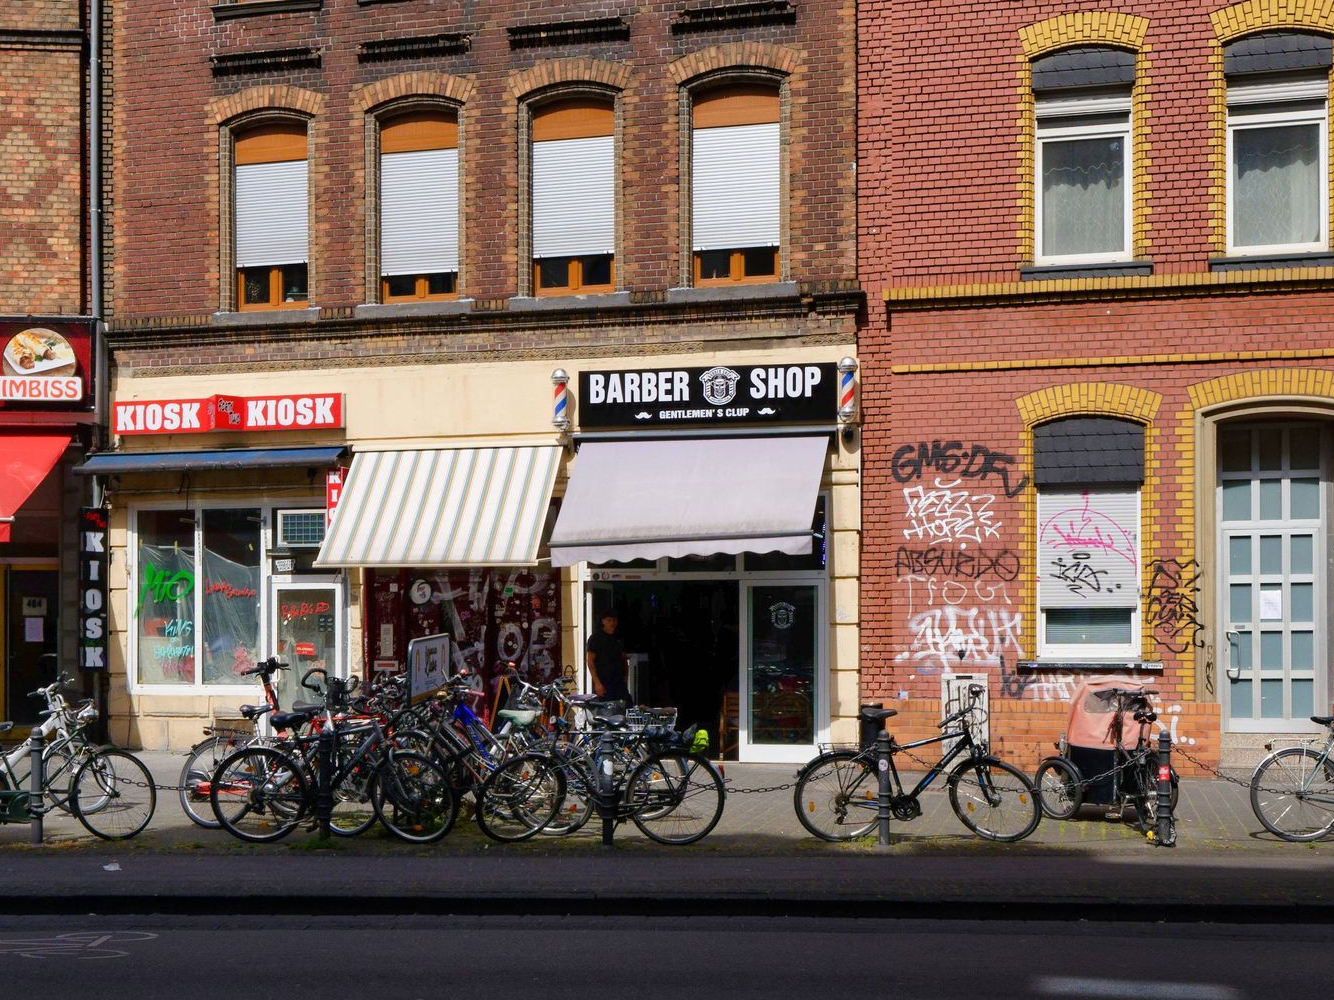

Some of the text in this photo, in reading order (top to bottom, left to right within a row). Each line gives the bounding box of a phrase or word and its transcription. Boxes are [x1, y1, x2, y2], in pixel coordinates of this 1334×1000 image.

[2, 380, 78, 398] IMBISS
[590, 366, 821, 404] BARBER SHOP
[116, 402, 200, 431] KIOSK
[247, 398, 334, 426] KIOSK
[726, 408, 749, 418] CLUP
[85, 532, 104, 667] KIOSK
